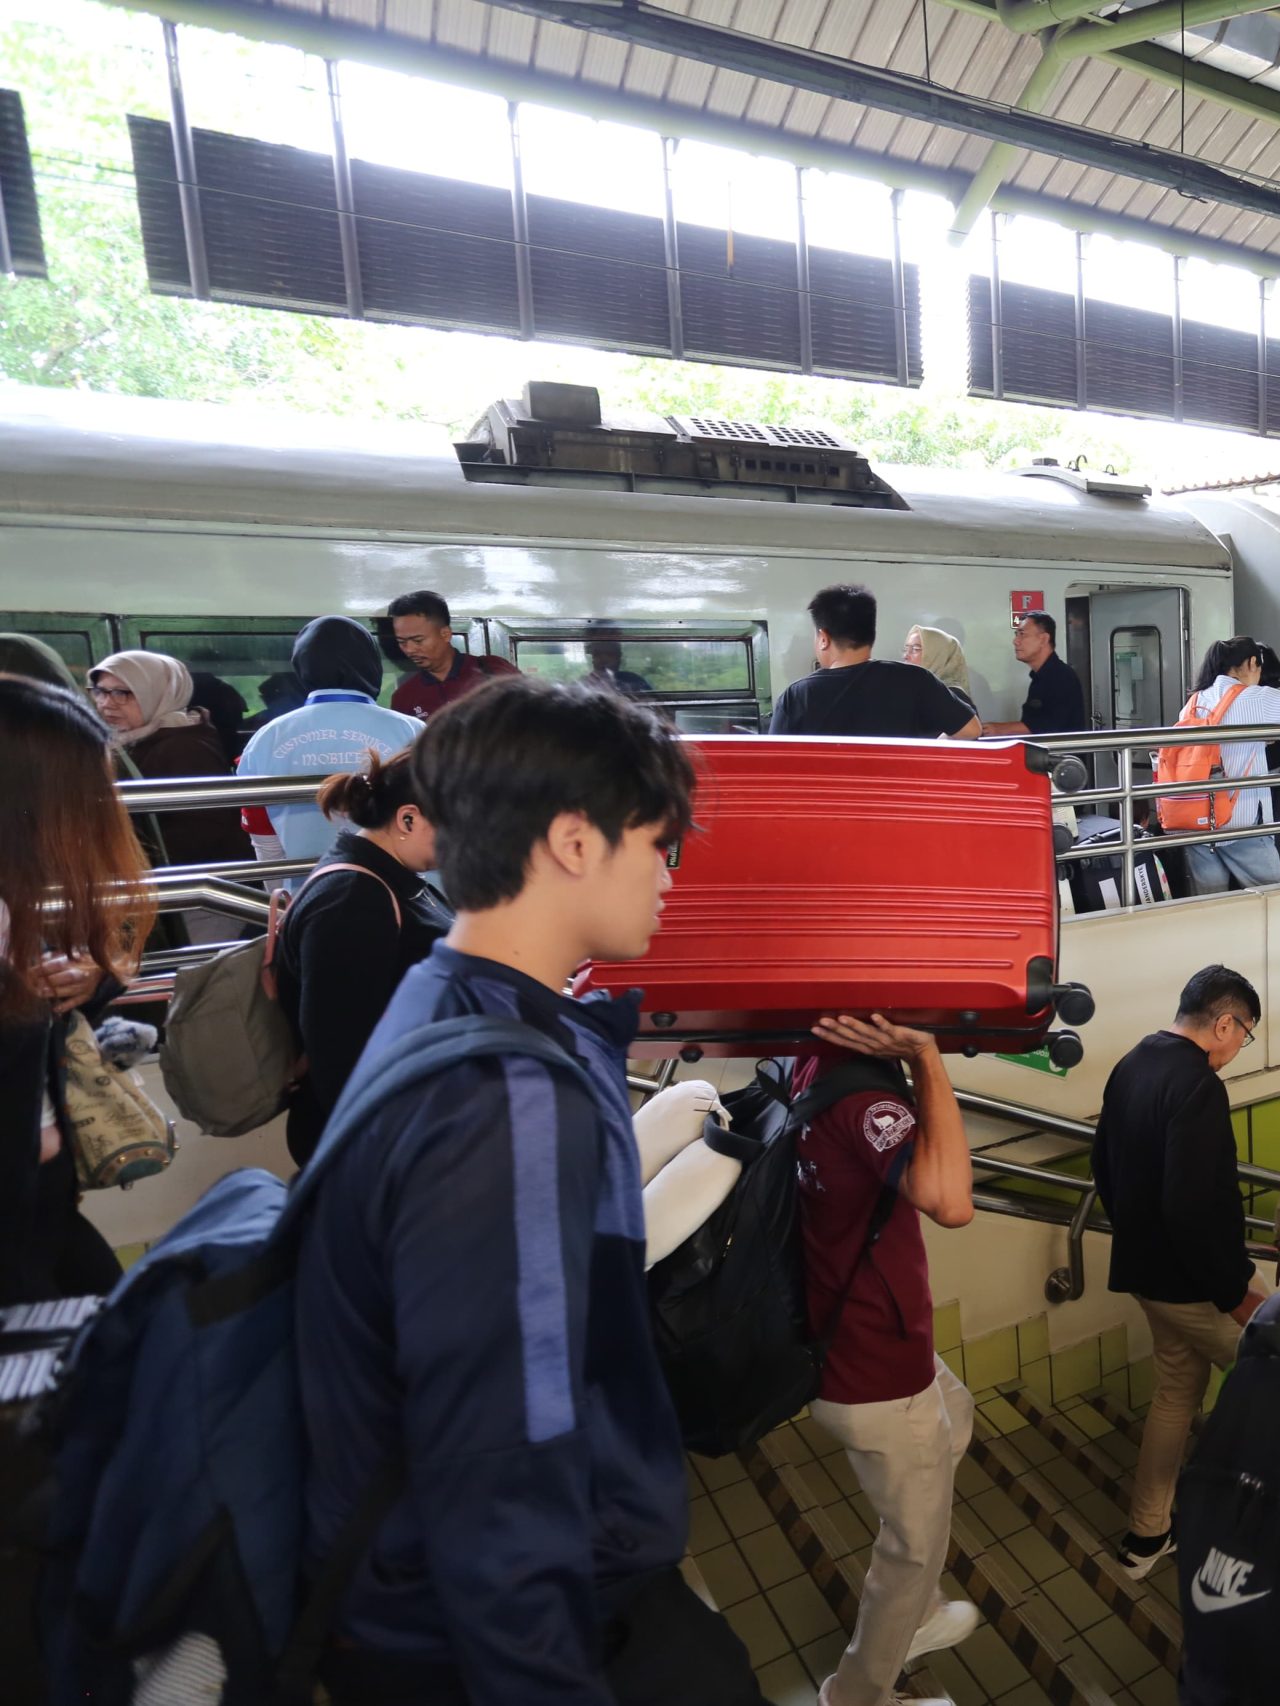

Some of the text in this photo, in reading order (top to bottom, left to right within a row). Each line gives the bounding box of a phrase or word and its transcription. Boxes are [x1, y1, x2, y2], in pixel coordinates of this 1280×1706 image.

[1022, 595, 1033, 609] F
[272, 729, 393, 759] CUSTOMER SERVICE
[1200, 1546, 1255, 1599] NIKE
